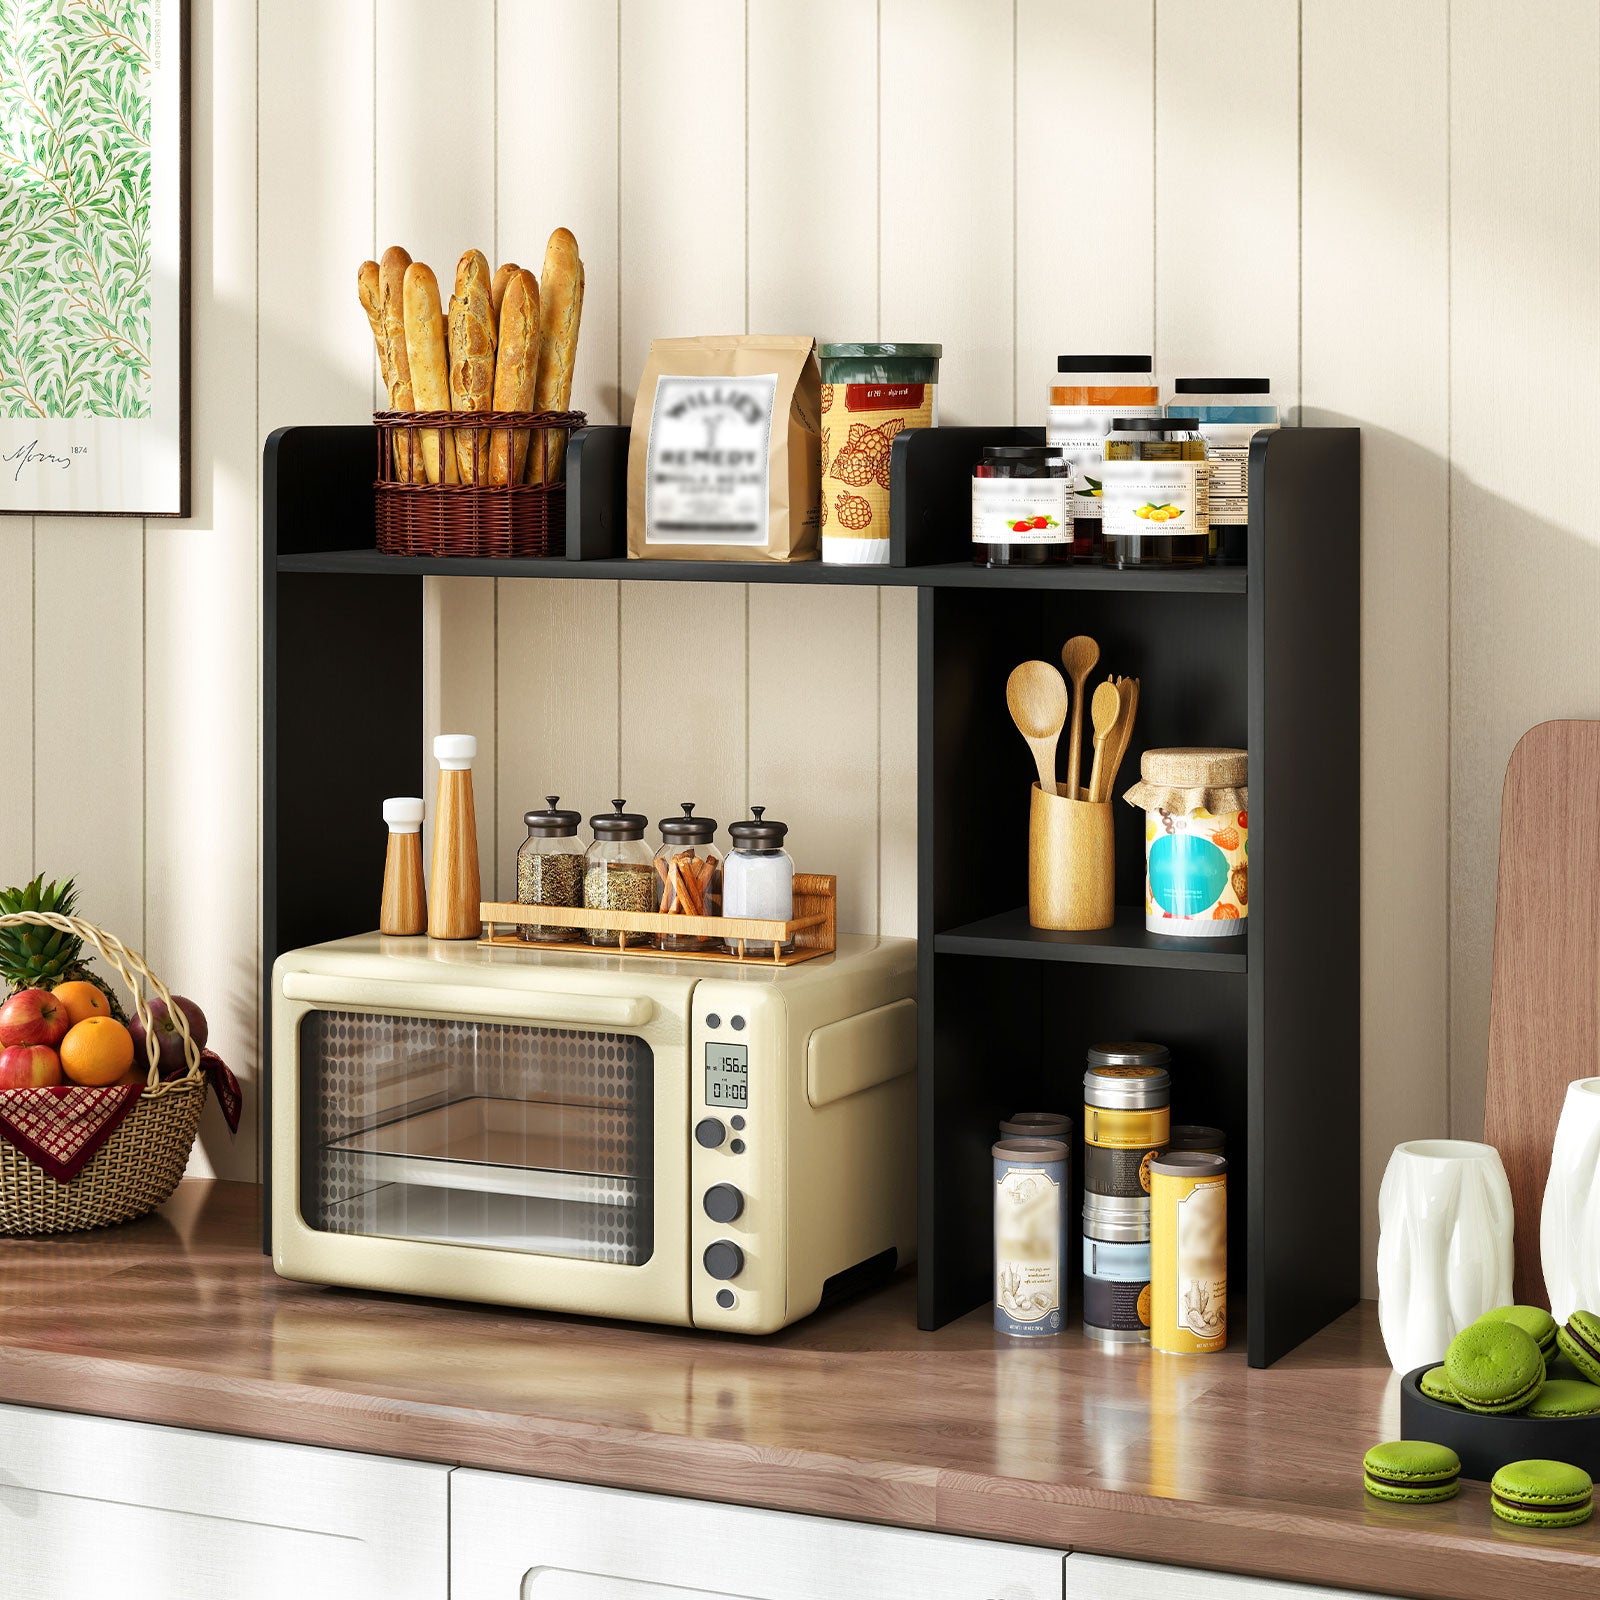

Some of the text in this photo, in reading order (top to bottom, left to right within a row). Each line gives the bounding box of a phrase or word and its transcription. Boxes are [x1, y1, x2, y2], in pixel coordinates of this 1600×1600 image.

[155, 60, 161, 70] BY
[71, 446, 88, 454] 1874
[714, 1083, 746, 1100] 01:00
